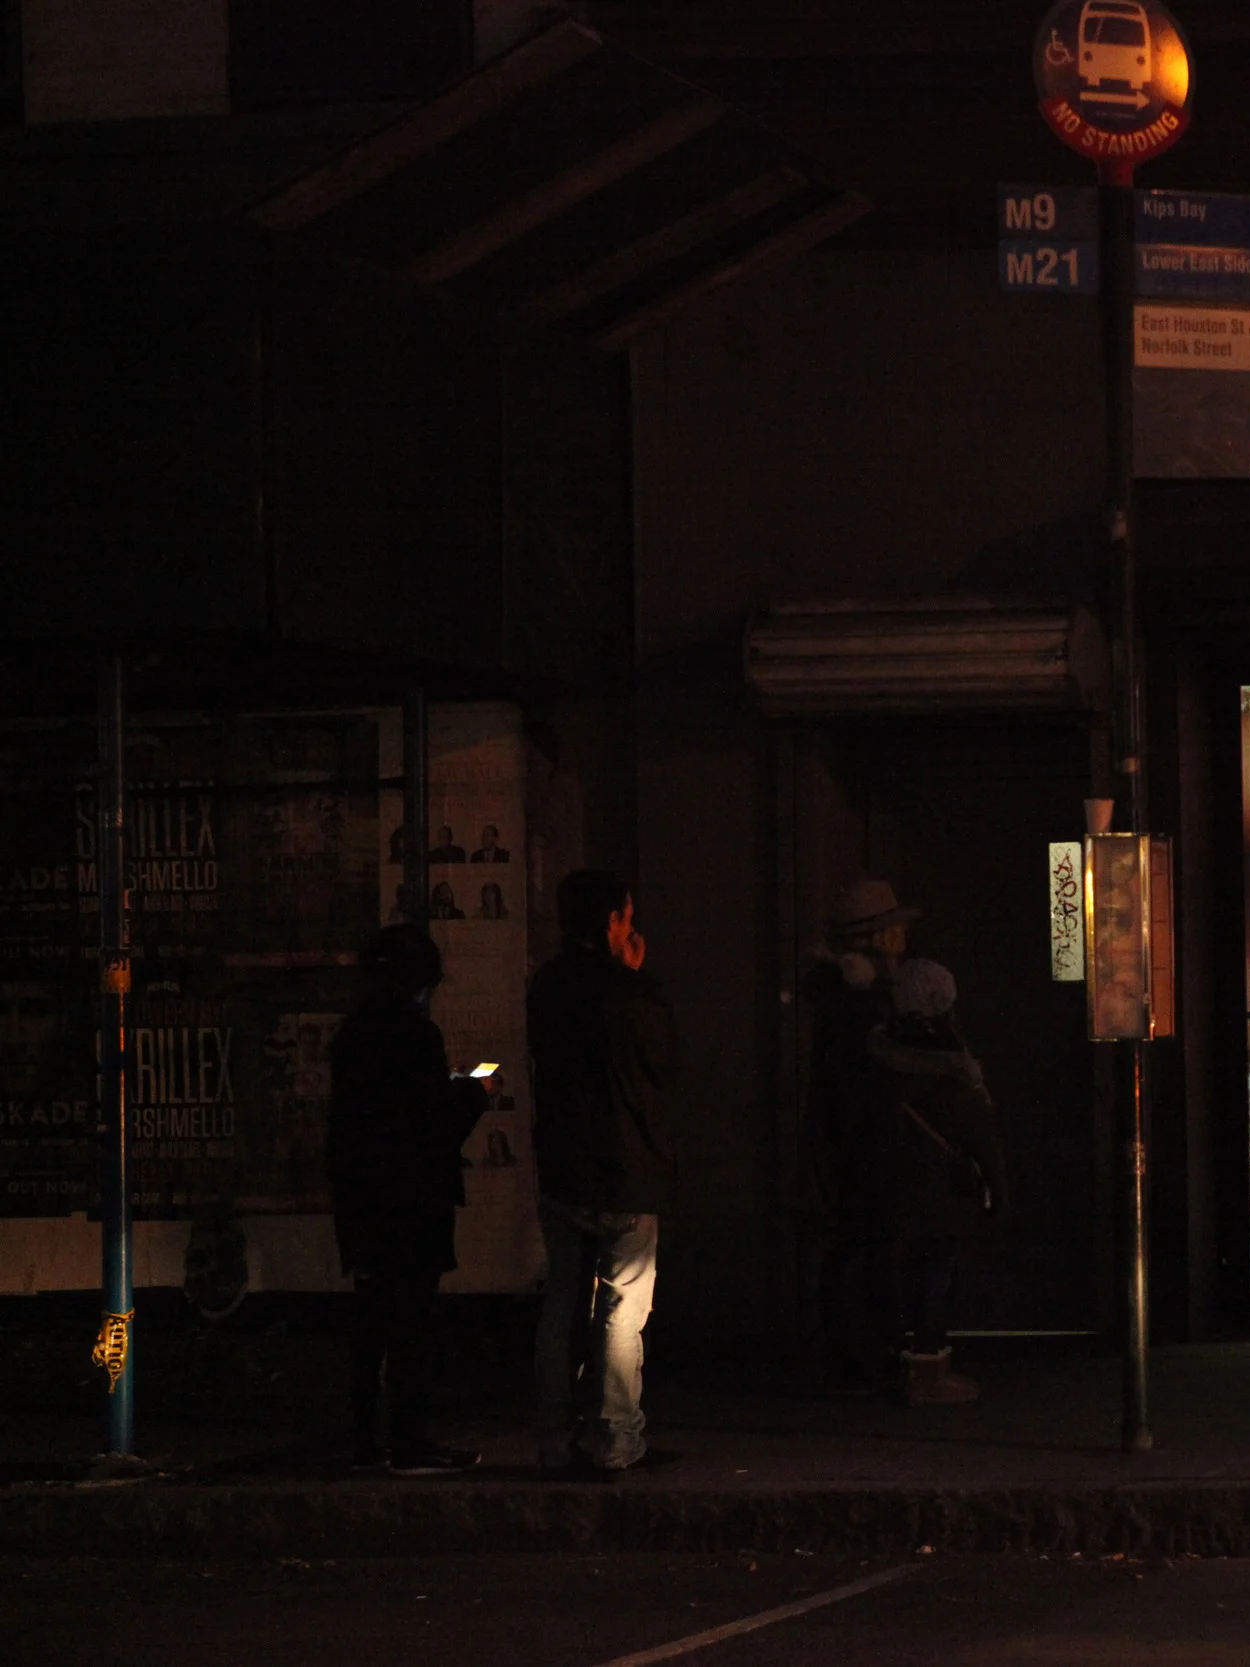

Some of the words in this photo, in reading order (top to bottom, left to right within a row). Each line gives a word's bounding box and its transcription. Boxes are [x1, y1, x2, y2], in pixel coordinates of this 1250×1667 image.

[1052, 101, 1081, 134] NO
[1081, 110, 1180, 155] STANDING
[1005, 193, 1056, 231] M9
[1143, 200, 1175, 219] Kips
[1180, 201, 1207, 224] Bay
[1007, 247, 1079, 286] M21
[1142, 252, 1185, 271] Lower
[1190, 254, 1220, 272] East
[1142, 315, 1169, 332] East
[1174, 316, 1227, 334] Houston
[1231, 318, 1245, 336] St
[1142, 337, 1188, 354] Norfolk
[1194, 340, 1232, 356] Street
[75, 780, 217, 859] SRILLEX
[0, 866, 68, 890] ADE
[77, 859, 219, 893] MSHMELLO
[96, 1027, 235, 1105] RILLEX
